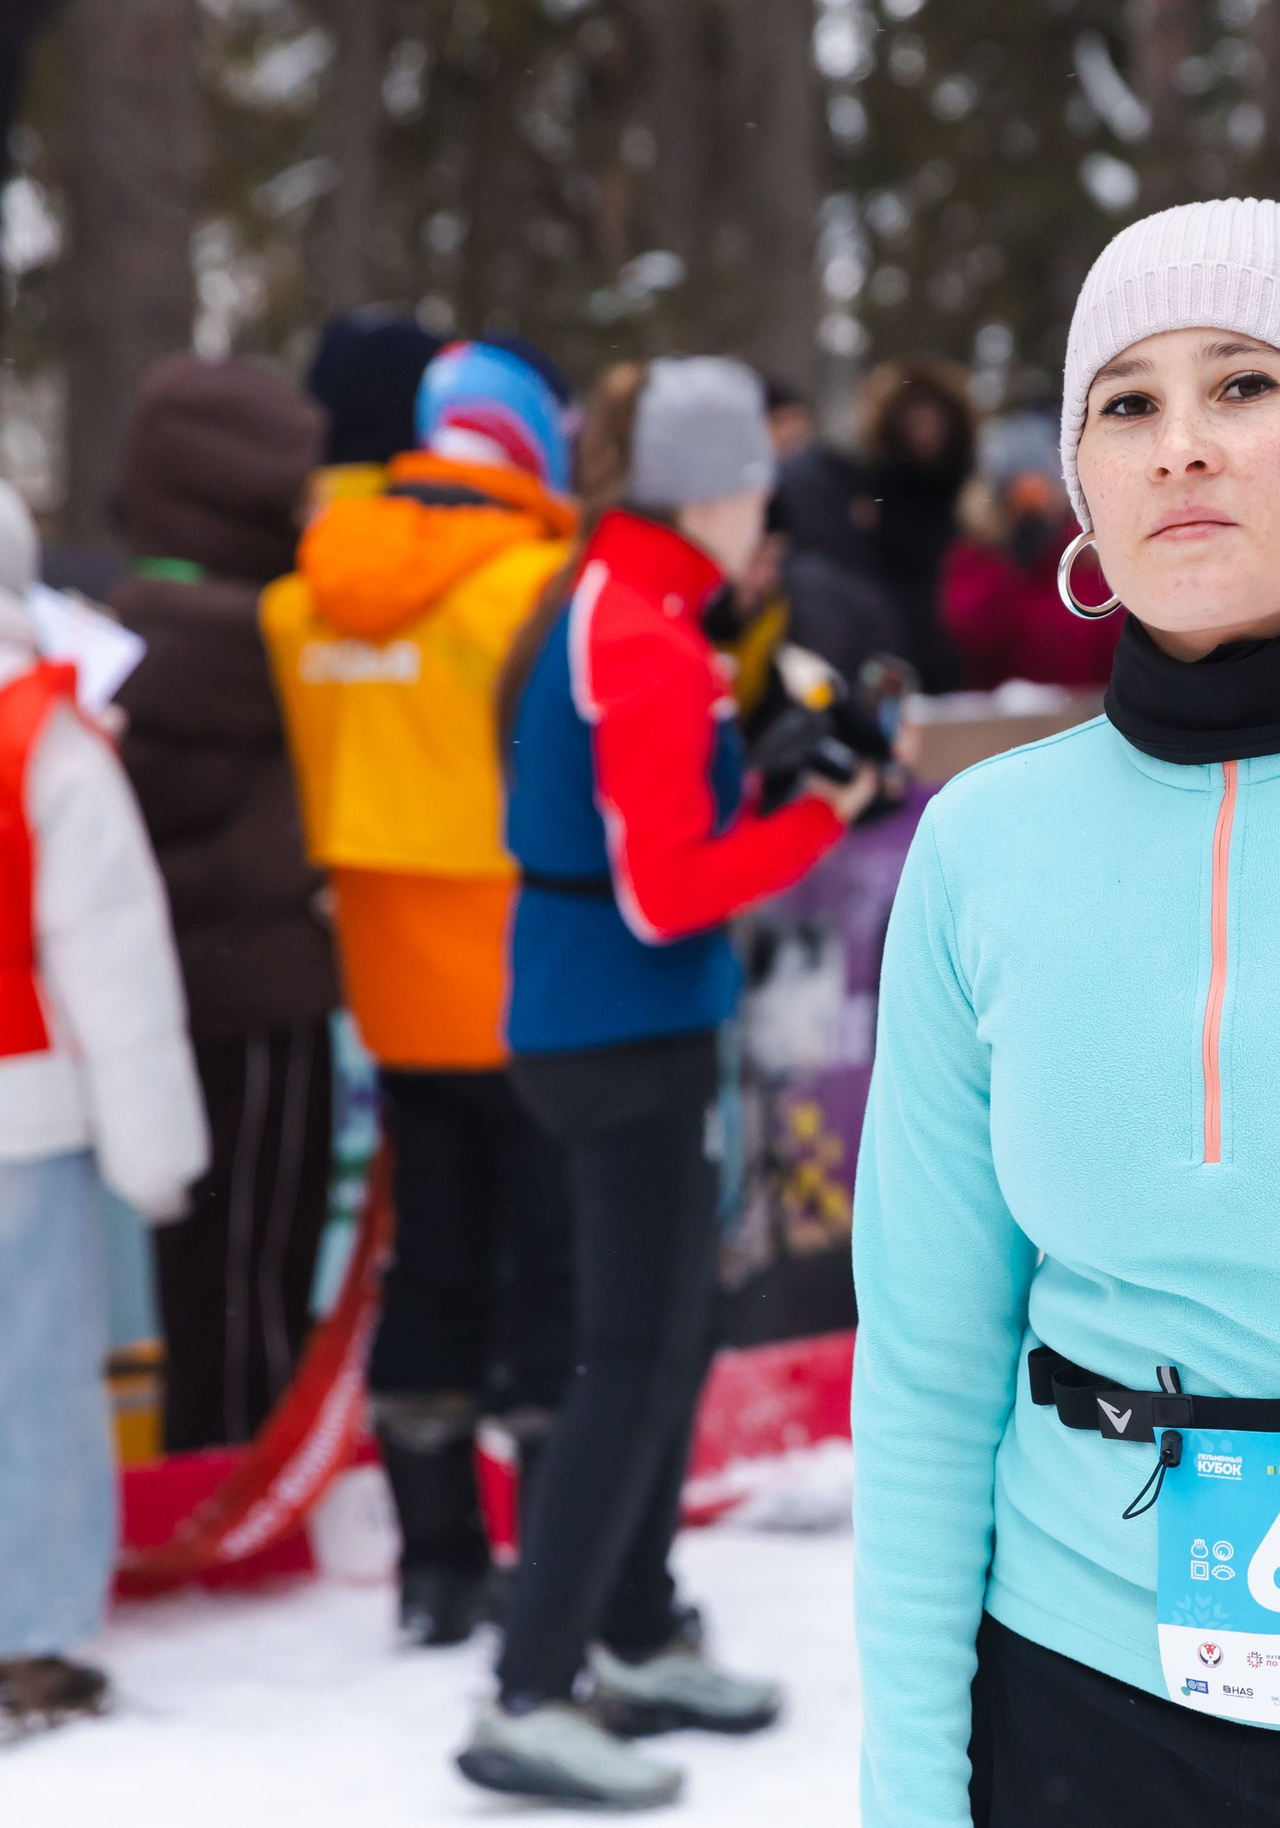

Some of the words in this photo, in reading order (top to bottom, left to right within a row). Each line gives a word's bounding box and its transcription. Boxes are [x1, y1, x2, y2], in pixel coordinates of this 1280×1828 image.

[1197, 1453, 1243, 1464] ПЕЛЬМЕННЫЙ
[1197, 1461, 1242, 1476] КУБОК
[1266, 1660, 1279, 1668] ПО
[1232, 1686, 1254, 1697] HAS
